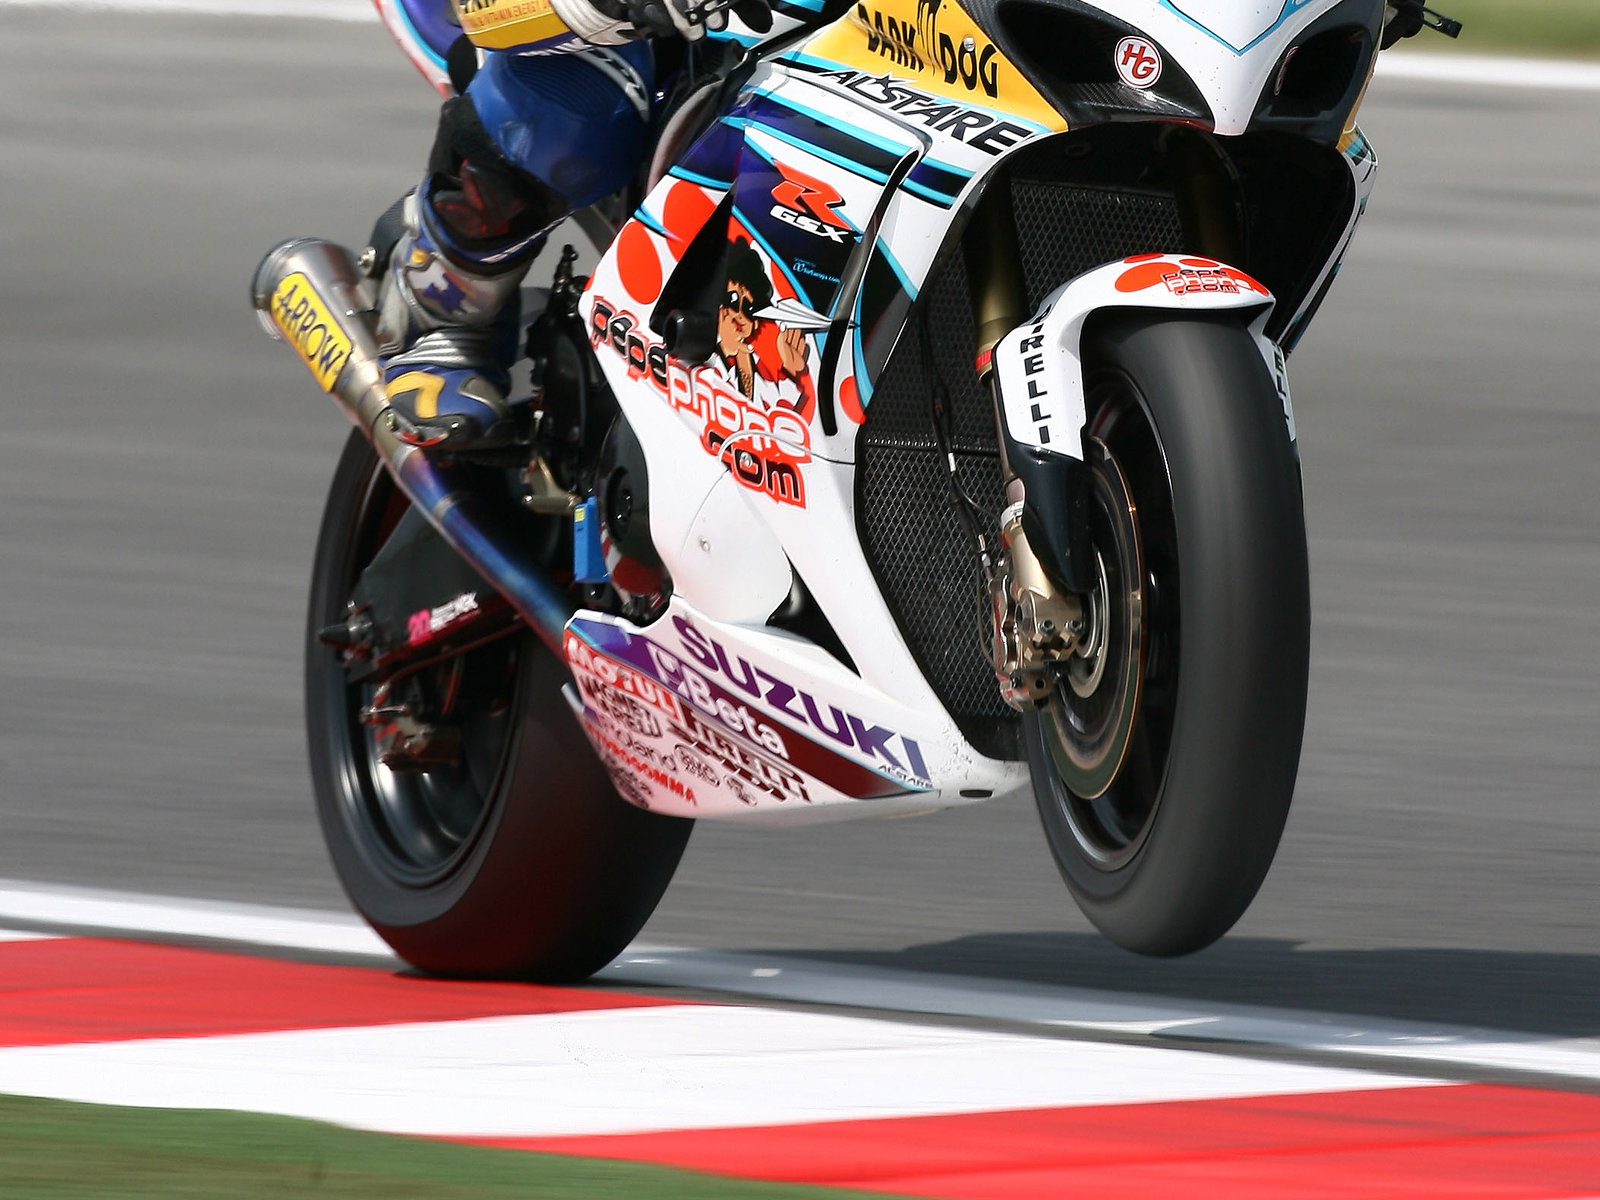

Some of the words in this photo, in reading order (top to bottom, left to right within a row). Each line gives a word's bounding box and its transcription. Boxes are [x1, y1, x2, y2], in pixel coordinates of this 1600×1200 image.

[857, 3, 924, 73] DARK
[939, 32, 999, 98] DOG
[1121, 43, 1156, 79] HG
[820, 70, 1034, 156] ALSTARE
[769, 204, 850, 244] GSX
[592, 302, 806, 458] pepephone
[1020, 303, 1052, 445] PIRELLI
[567, 637, 675, 716] MOTUL
[672, 613, 931, 781] SUZUKI
[686, 669, 790, 761] Beta
